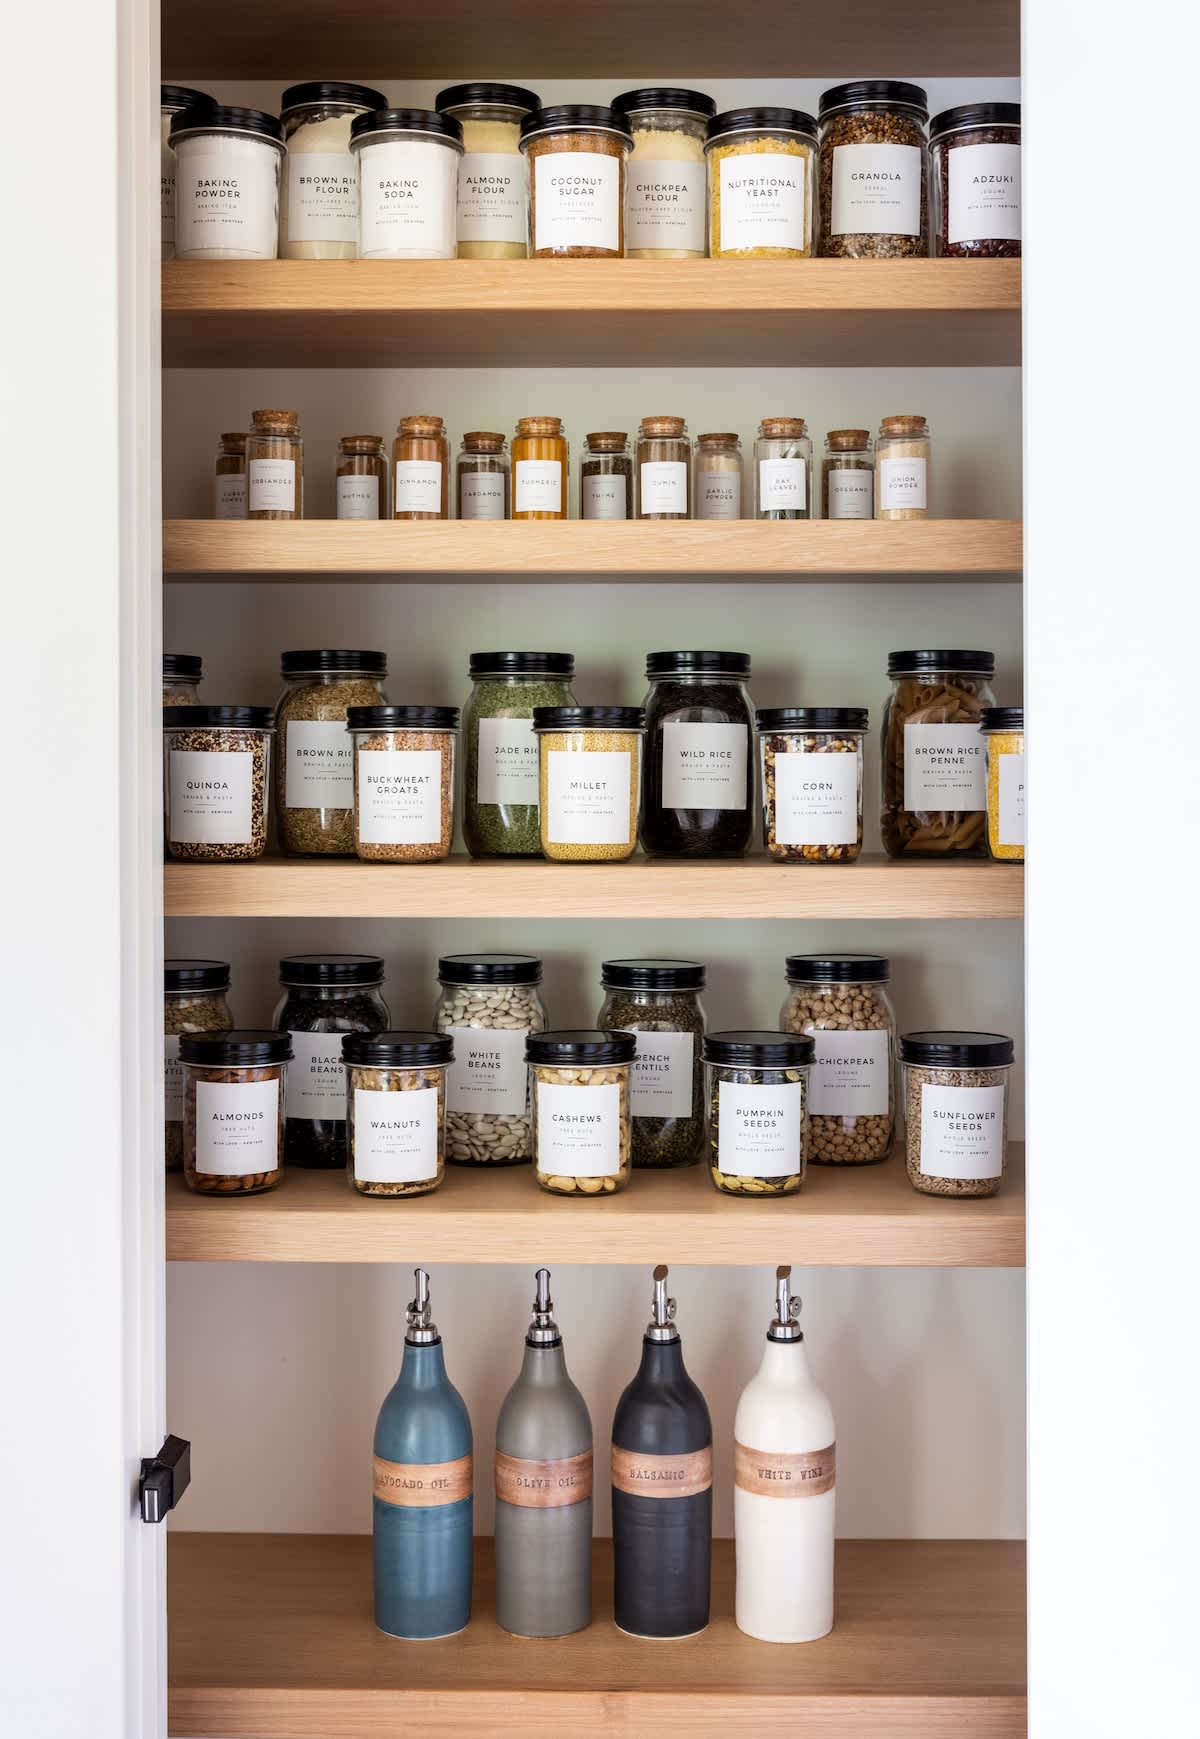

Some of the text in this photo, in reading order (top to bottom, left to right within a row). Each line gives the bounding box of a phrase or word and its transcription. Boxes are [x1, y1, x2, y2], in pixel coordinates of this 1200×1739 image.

[299, 176, 337, 185] BROWN
[466, 177, 511, 185] ALMOND
[551, 177, 603, 186] COCONUT
[851, 173, 901, 181] GRANOLA
[973, 175, 1014, 184] ADZUKI
[197, 180, 238, 188] BAKING
[379, 180, 419, 189] BAKING
[636, 184, 688, 193] CHICKPEA
[728, 178, 797, 190] NUTRITIONAL
[316, 185, 349, 194] FLOUR
[471, 186, 505, 194] FLOUR
[559, 187, 595, 196] SUGAR
[746, 188, 779, 198] YEAST
[195, 190, 241, 199] POWDER
[384, 190, 414, 199] SODA
[645, 193, 679, 202] FLOUR
[296, 749, 333, 758] BROWN
[495, 746, 520, 754] JADE
[680, 750, 732, 759] WILD RICE
[915, 747, 980, 755] BROWN RICE
[930, 757, 965, 765] PENNE
[368, 775, 431, 784] BUCKWHEAT
[186, 781, 228, 790] QUINOA
[377, 786, 419, 794] GROATS
[570, 782, 607, 790] MILLET
[802, 783, 833, 791] CORN
[311, 1056, 342, 1064] BLAC
[469, 1051, 501, 1060] WHITE
[636, 1054, 670, 1062] RENCH
[468, 1060, 501, 1069] BEANS
[818, 1057, 874, 1065] CHICKPEAS
[310, 1065, 344, 1074] BEANS
[212, 1112, 264, 1121] ALMONDS
[736, 1109, 784, 1117] PUMPKIN
[933, 1110, 996, 1121] SUNFLOWER
[552, 1114, 602, 1123] CASHEWS
[744, 1119, 776, 1127] SEEDS
[370, 1120, 421, 1129] WALNUTS
[949, 1122, 982, 1130] SEEDS
[630, 1469, 685, 1481] BALSAMIC
[757, 1467, 823, 1481] WHITE WINE
[377, 1474, 449, 1489] AVOCADO OIL
[515, 1476, 576, 1488] OLIVE OIL
